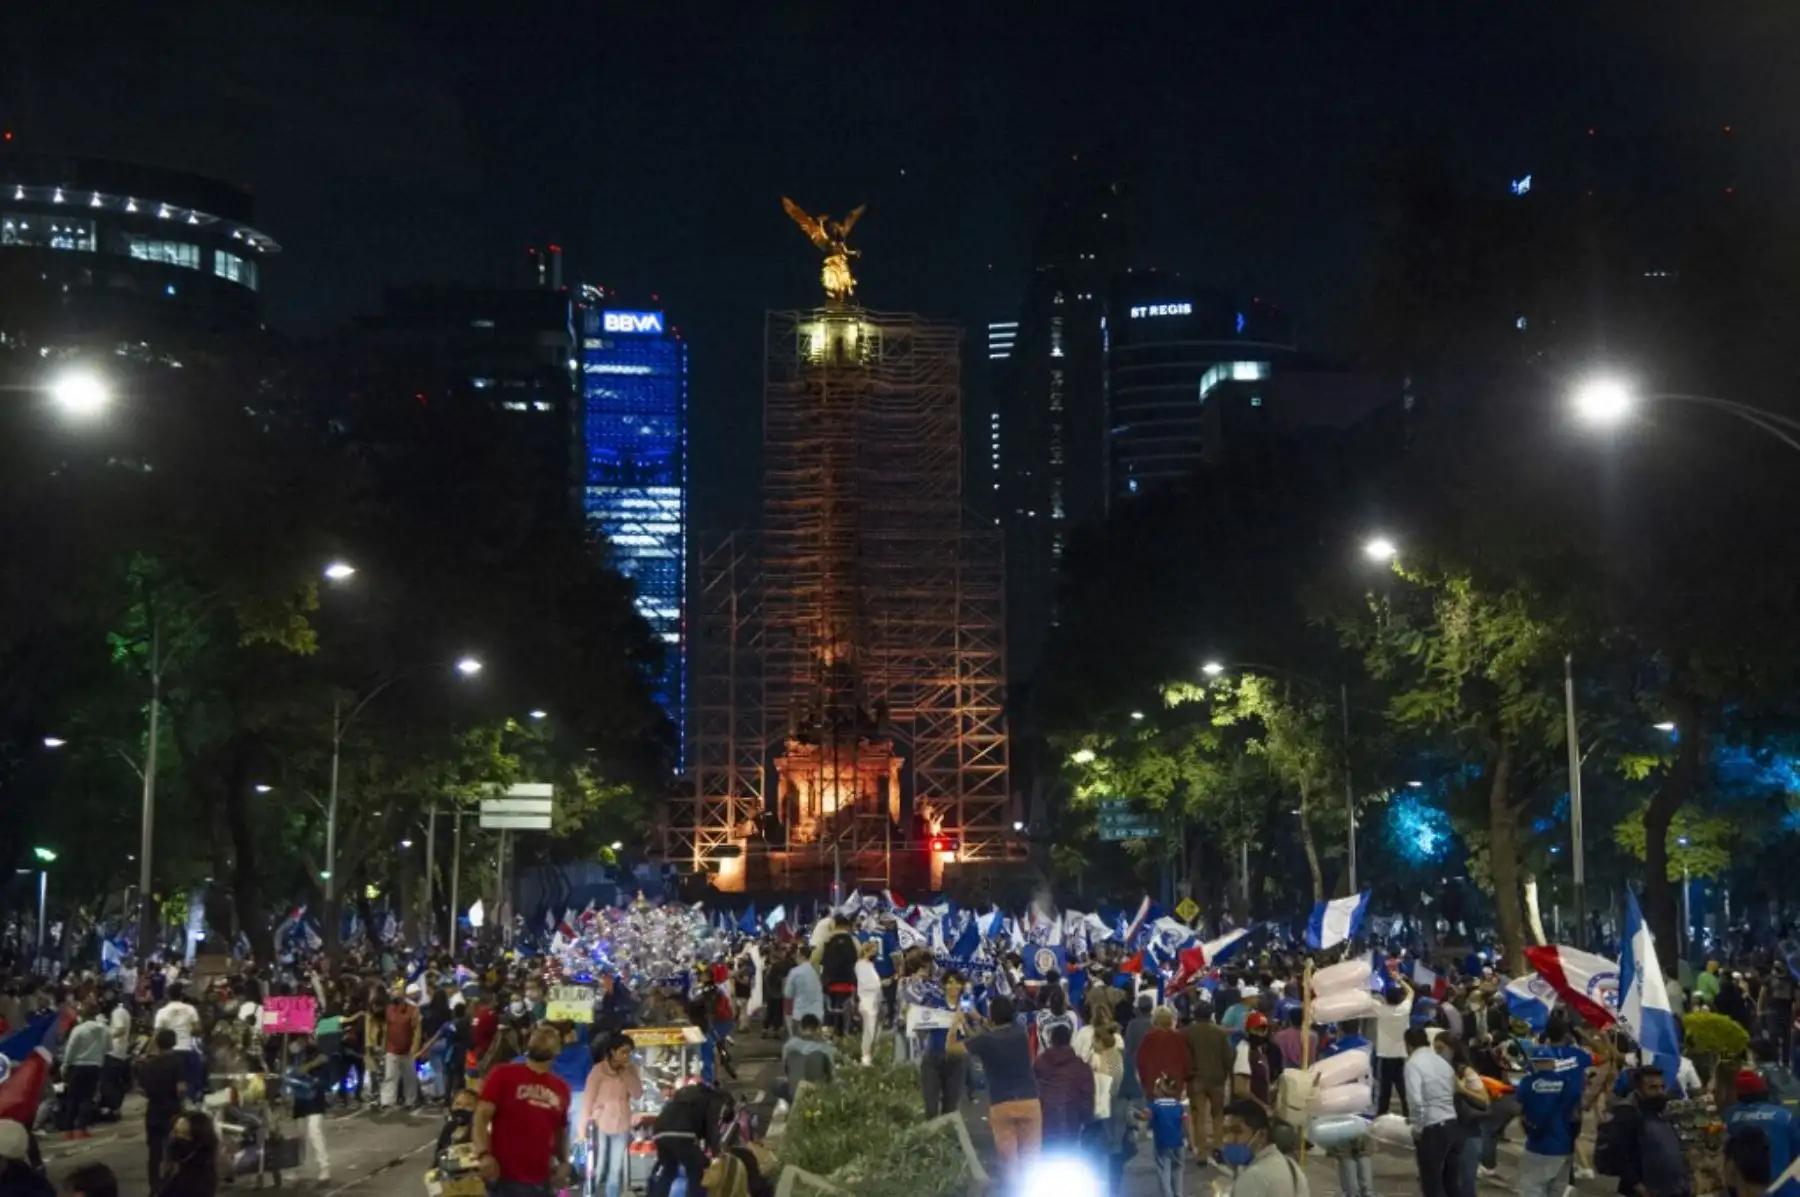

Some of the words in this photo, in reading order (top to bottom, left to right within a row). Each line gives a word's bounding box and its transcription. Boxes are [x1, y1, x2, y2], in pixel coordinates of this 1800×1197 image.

[1131, 306, 1147, 318] ST
[1149, 303, 1192, 316] REGIS
[604, 313, 662, 332] BBVA
